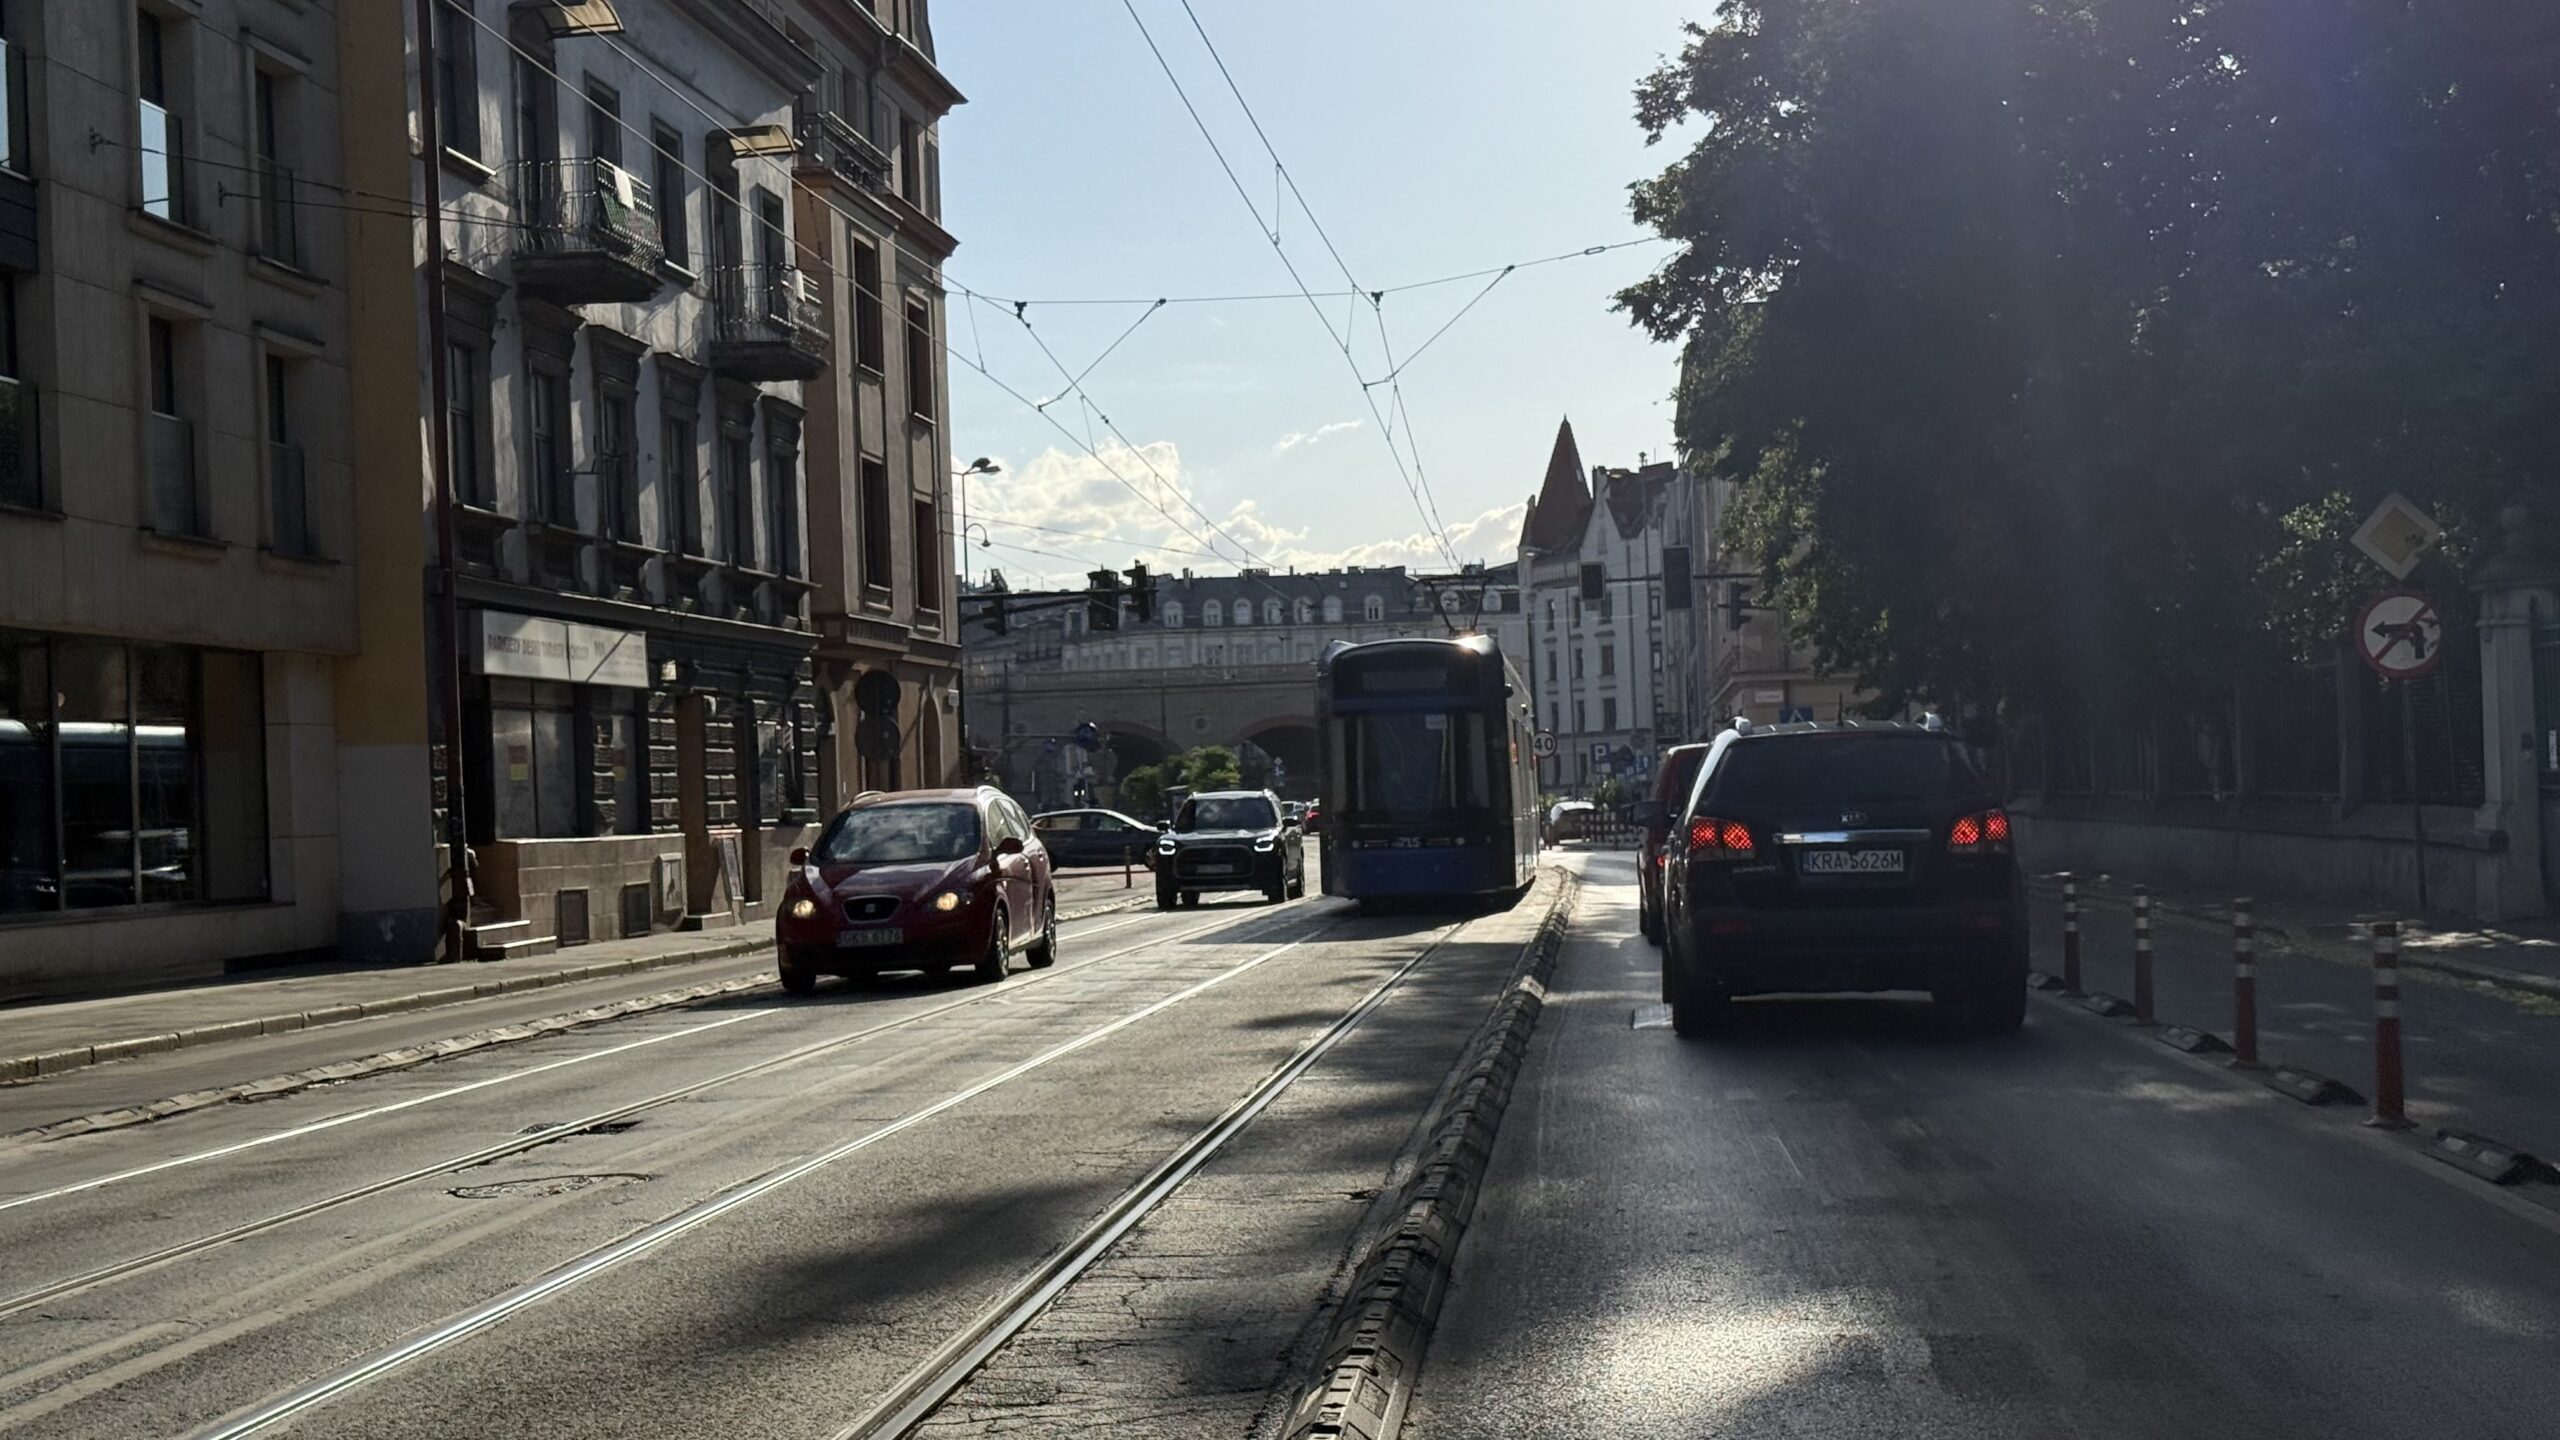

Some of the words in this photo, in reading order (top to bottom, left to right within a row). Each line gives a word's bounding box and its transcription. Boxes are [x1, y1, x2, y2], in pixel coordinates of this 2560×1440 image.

[1534, 737, 1554, 751] 40
[1594, 745, 1607, 761] P
[1810, 853, 1843, 870] KRA
[1850, 852, 1901, 869] 5626M
